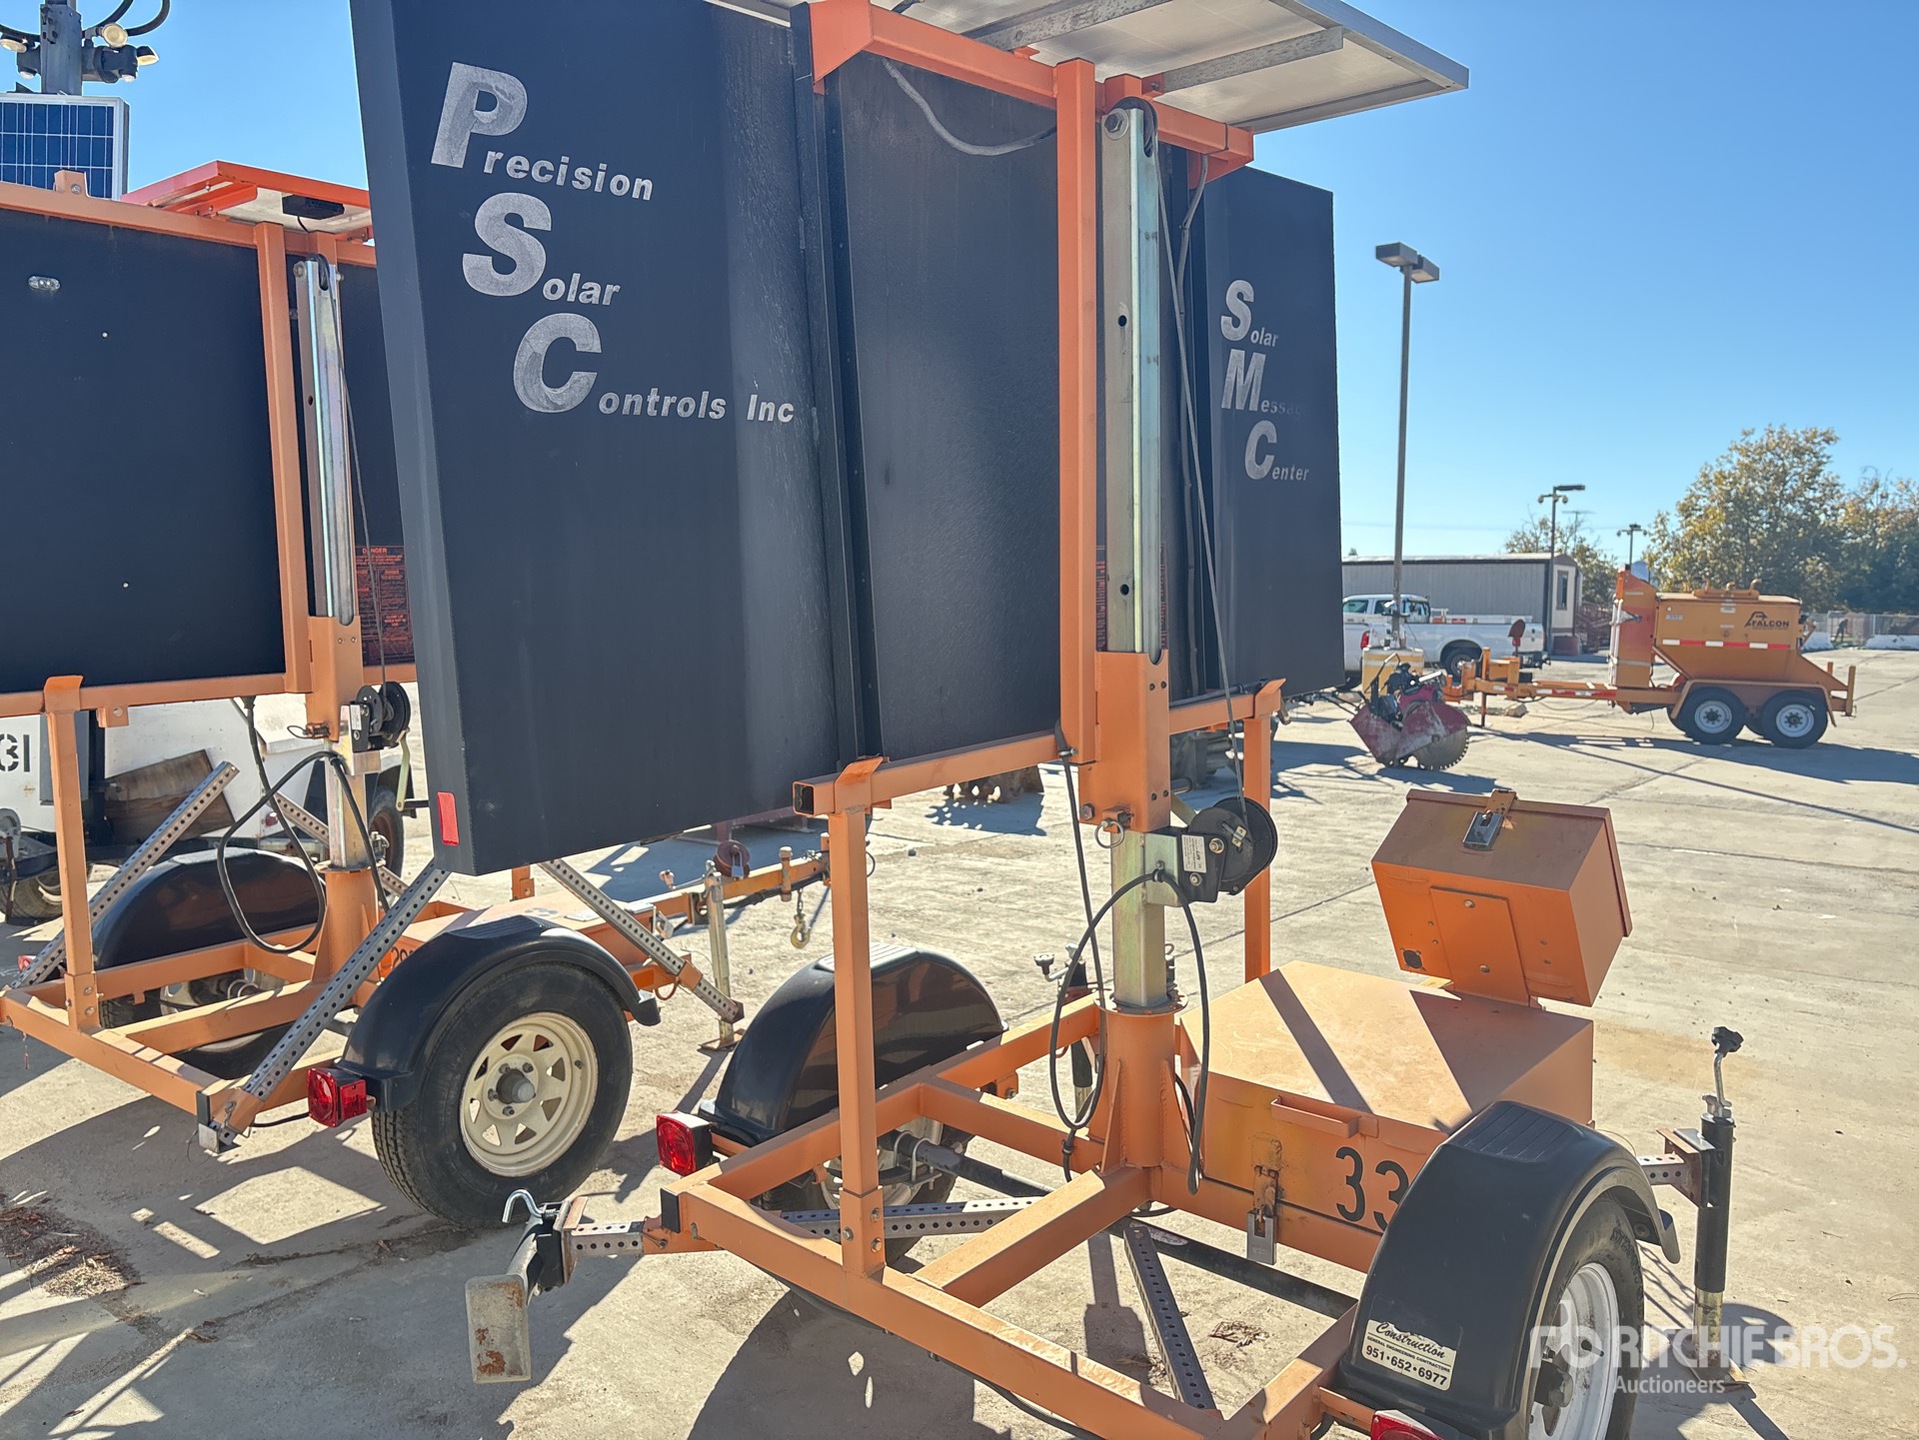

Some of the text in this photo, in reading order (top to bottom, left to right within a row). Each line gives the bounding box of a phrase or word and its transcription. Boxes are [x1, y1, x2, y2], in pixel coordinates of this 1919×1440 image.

[431, 62, 654, 201] Precision
[462, 192, 621, 306] Solar
[1220, 279, 1279, 347] Solar
[513, 312, 795, 423] Controls Inc
[1221, 348, 1308, 421] Messag
[1244, 420, 1310, 480] Center
[1751, 619, 1790, 628] FALCON
[1375, 1322, 1446, 1359] Construction
